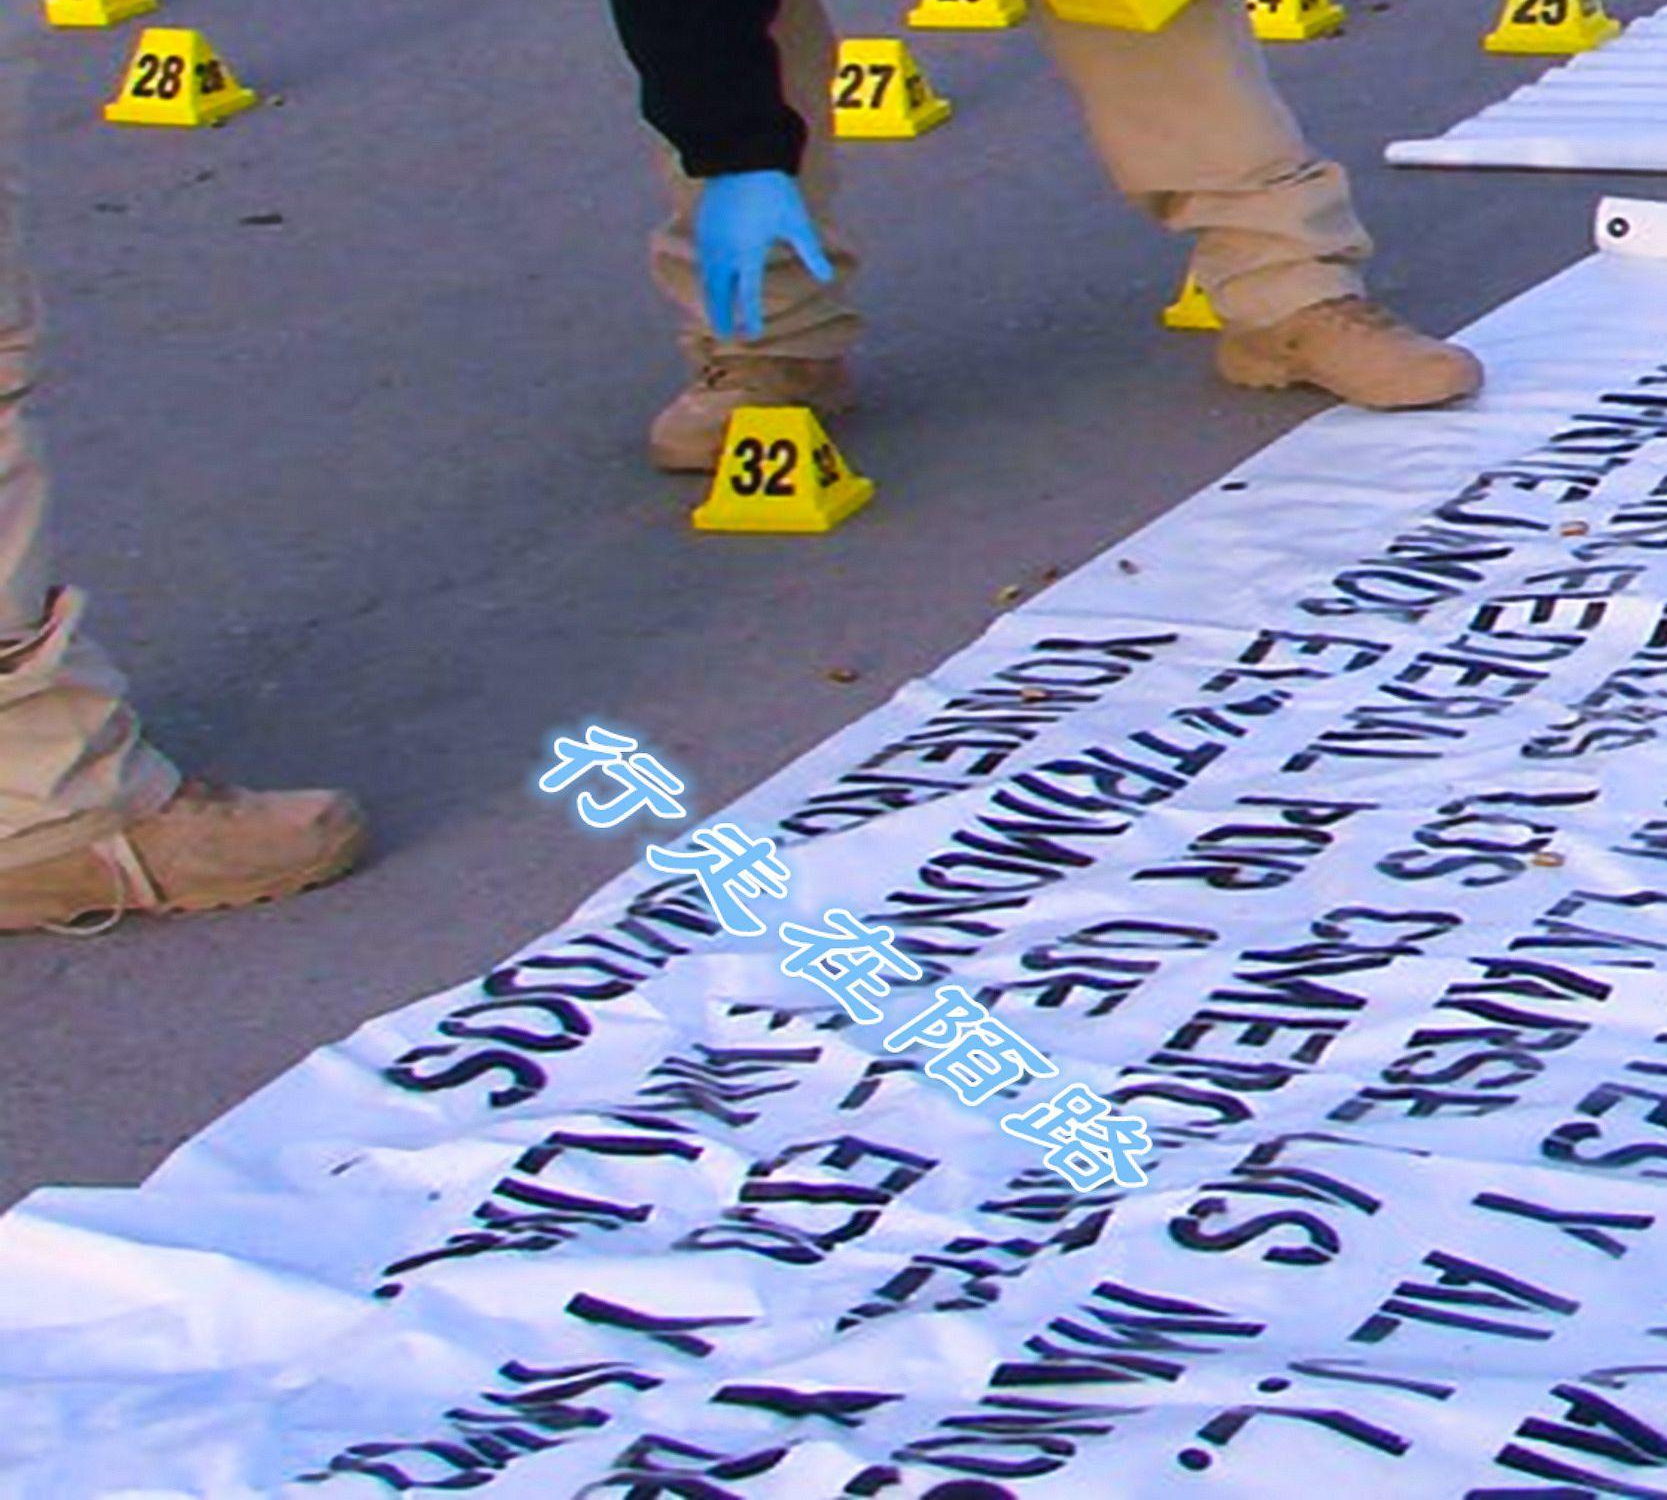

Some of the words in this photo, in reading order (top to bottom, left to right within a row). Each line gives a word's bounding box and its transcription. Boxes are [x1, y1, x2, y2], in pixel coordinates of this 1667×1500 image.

[125, 50, 185, 101] 28
[831, 60, 896, 110] 27
[724, 431, 799, 498] 32
[1281, 566, 1645, 772] FEDERAL
[772, 634, 1178, 847] YONKERO
[1131, 797, 1380, 890] POR
[1376, 791, 1599, 887] LOS
[1168, 1133, 1430, 1266] LAS
[1423, 1193, 1654, 1261] Y
[565, 1294, 752, 1358] Y
[1349, 1251, 1626, 1343] AL
[710, 1386, 904, 1428] Y
